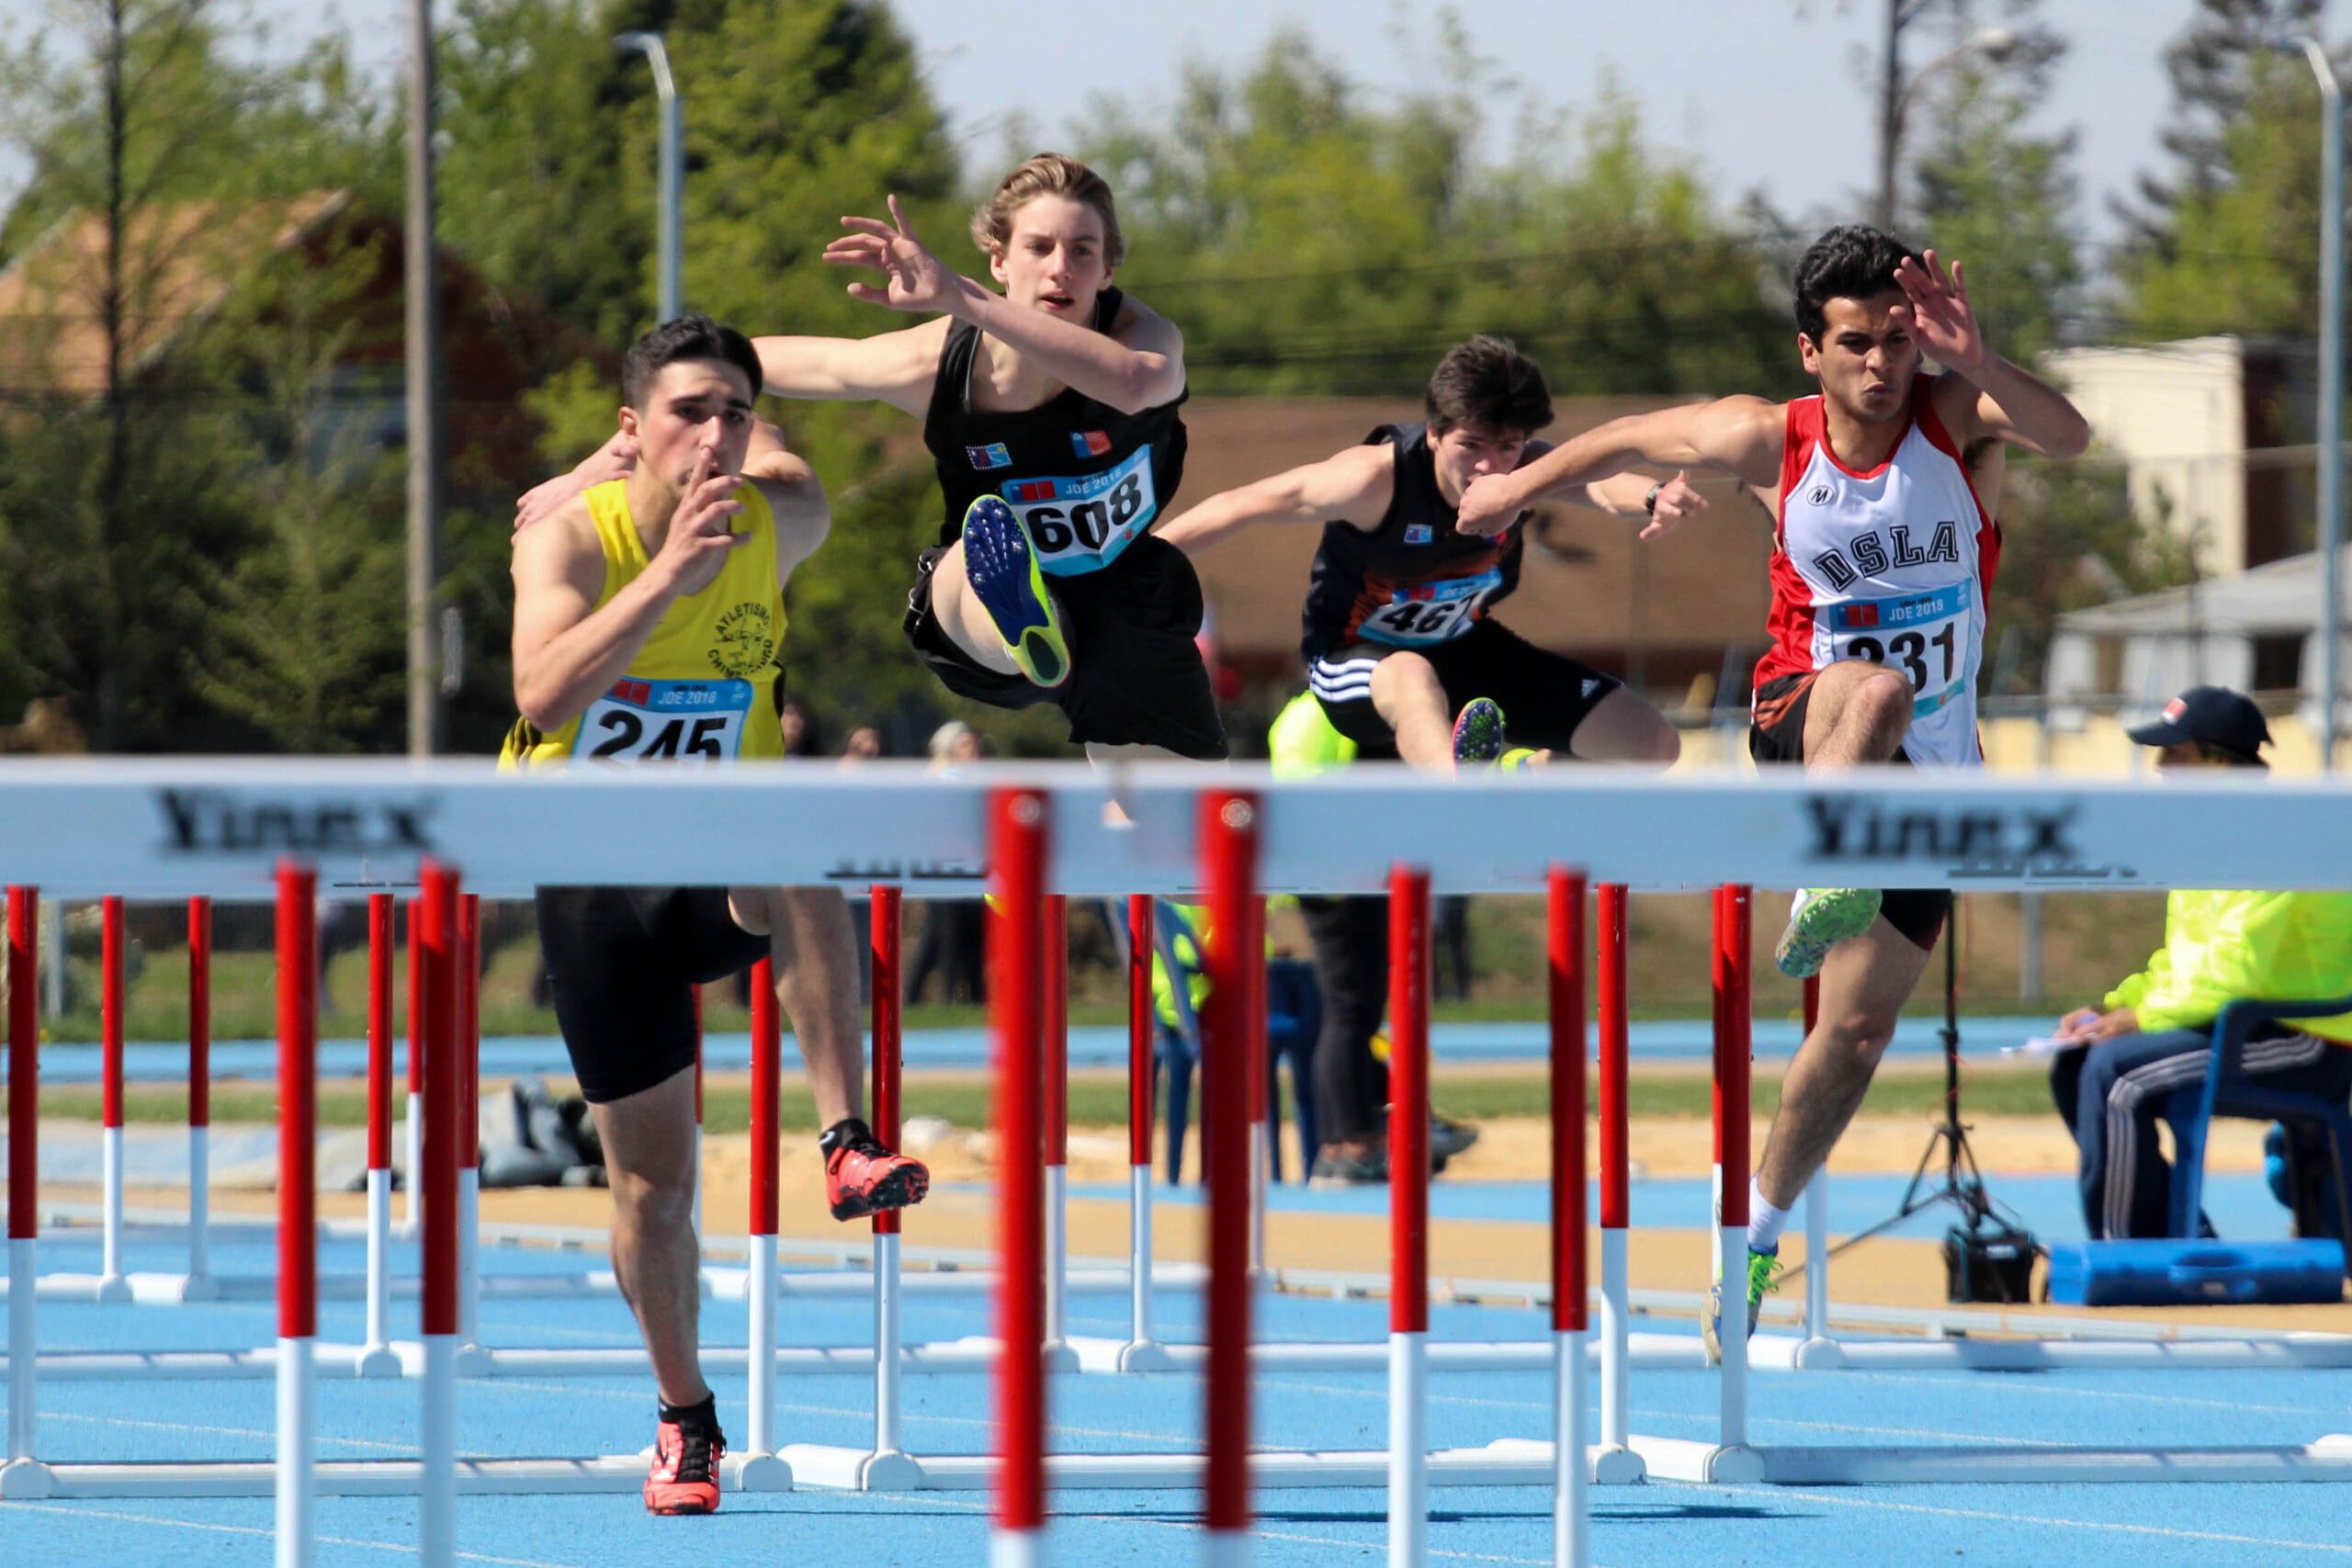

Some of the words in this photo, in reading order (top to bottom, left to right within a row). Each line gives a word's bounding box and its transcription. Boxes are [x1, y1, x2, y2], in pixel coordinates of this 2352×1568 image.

[1066, 480, 1091, 495] JDE
[1025, 472, 1142, 554] 608
[1813, 521, 1959, 592] DSLA
[715, 603, 770, 635] ATLETISMO
[1889, 606, 1914, 622] JDE
[1916, 598, 1944, 617] 2018
[657, 691, 684, 705] JDE
[685, 691, 718, 705] 2018
[589, 709, 728, 764] 245
